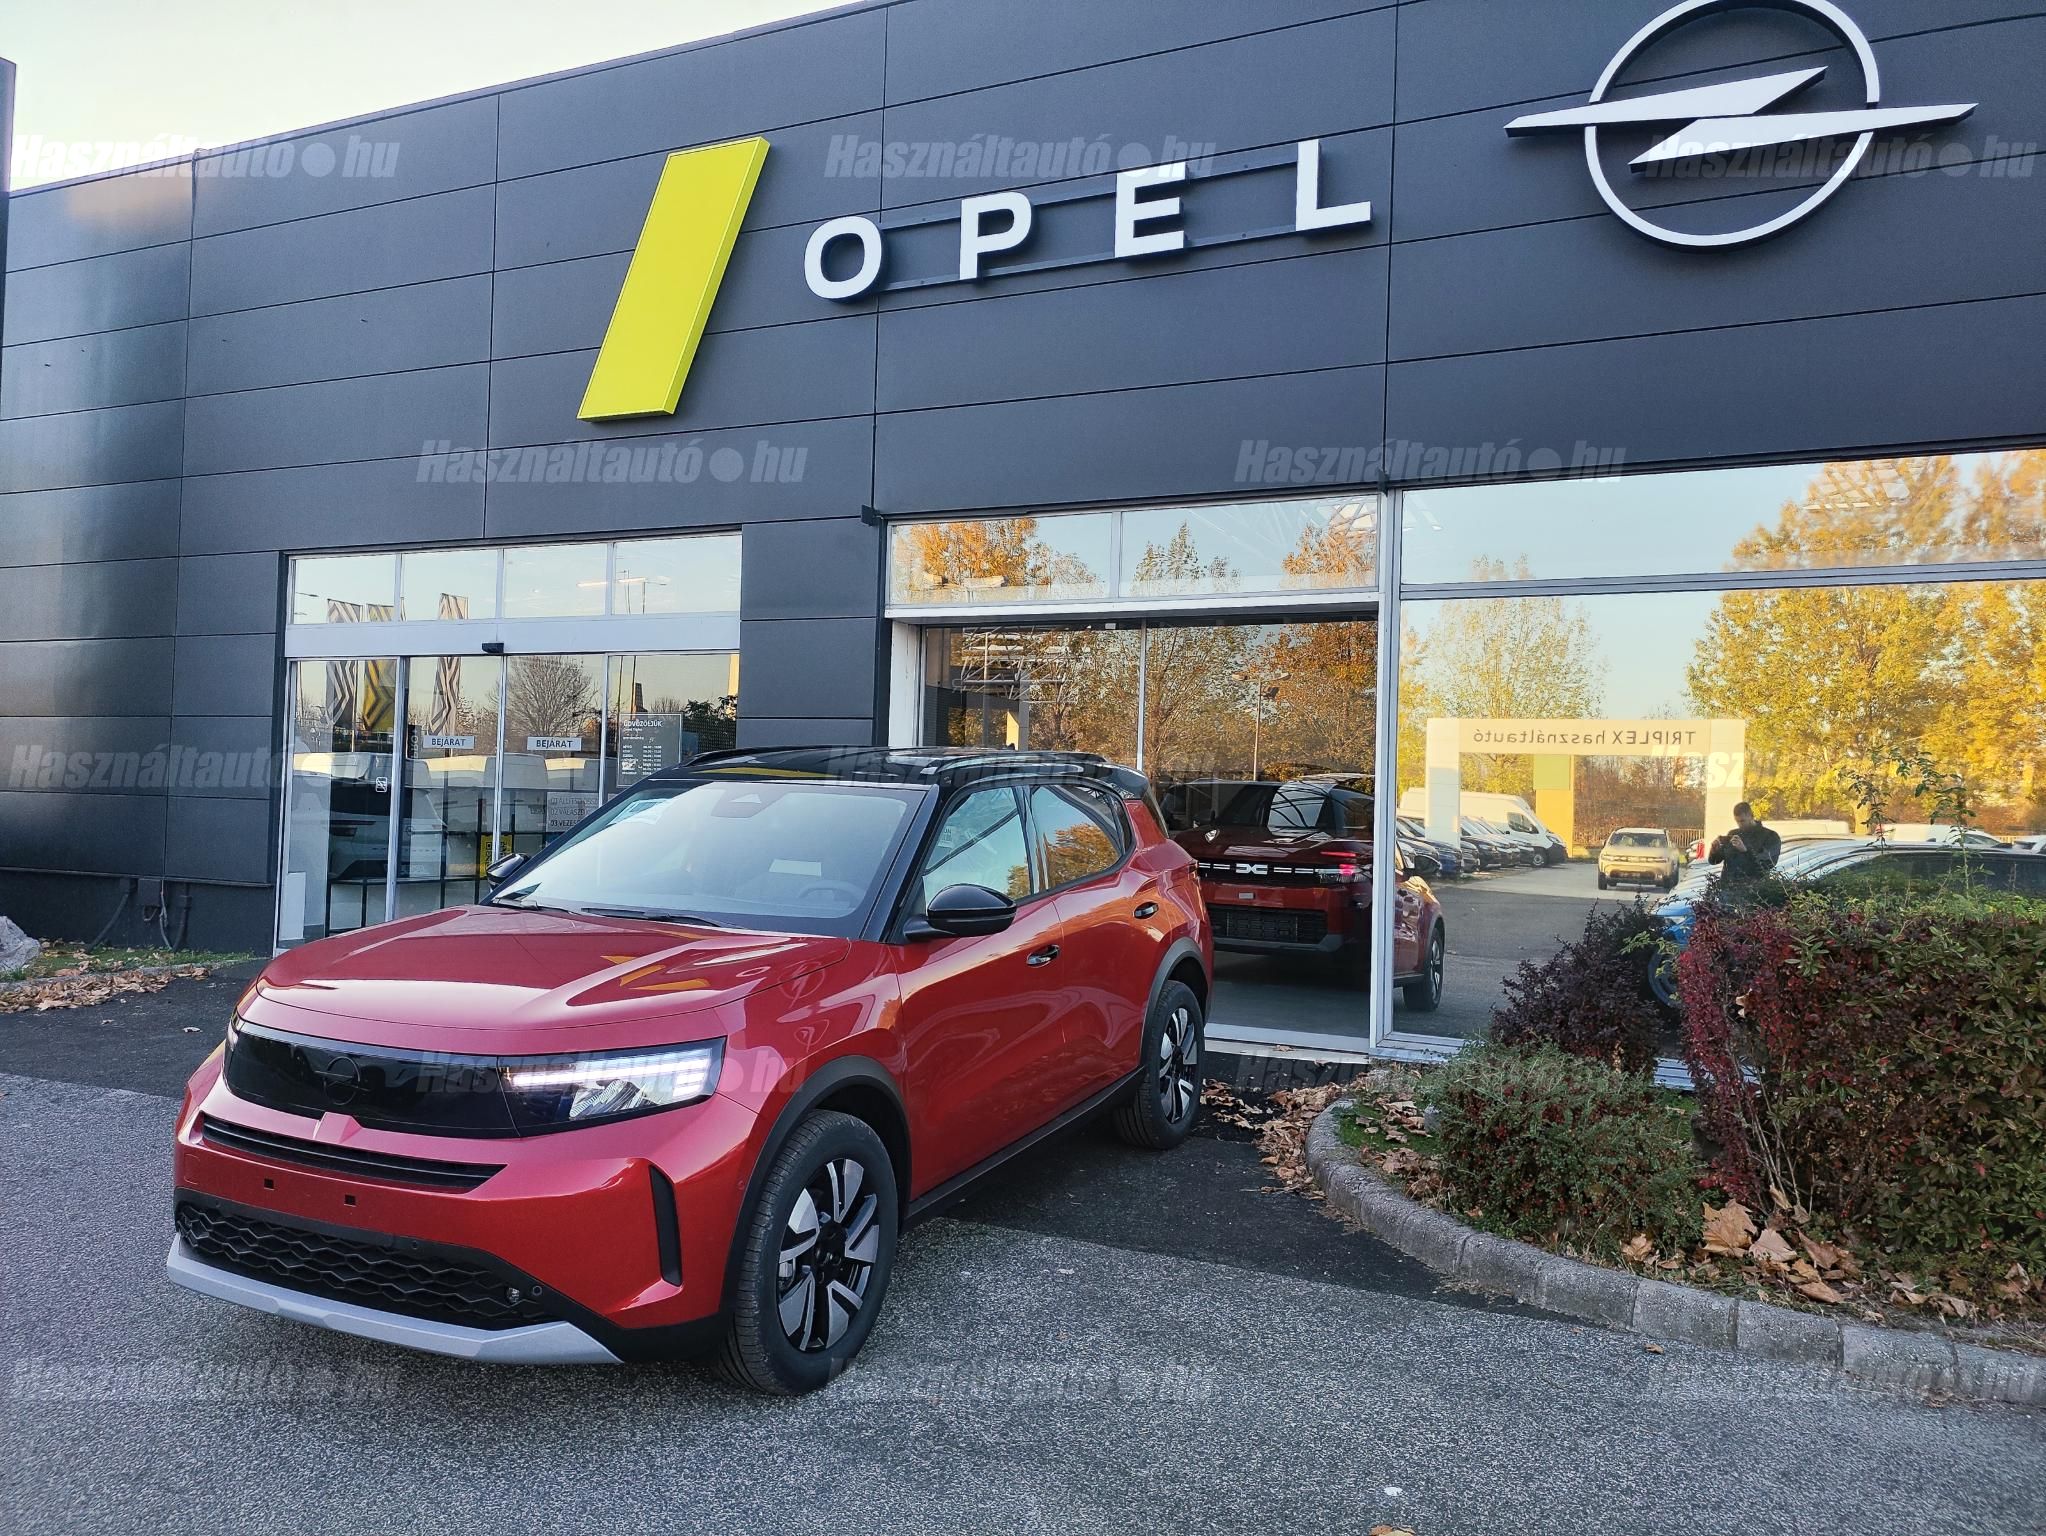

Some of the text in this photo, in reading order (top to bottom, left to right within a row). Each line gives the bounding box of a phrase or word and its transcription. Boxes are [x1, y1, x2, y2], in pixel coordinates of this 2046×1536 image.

[804, 137, 1372, 300] OPEL
[431, 737, 466, 747] BEJÁRAT
[536, 738, 573, 749] BEJÁRAT
